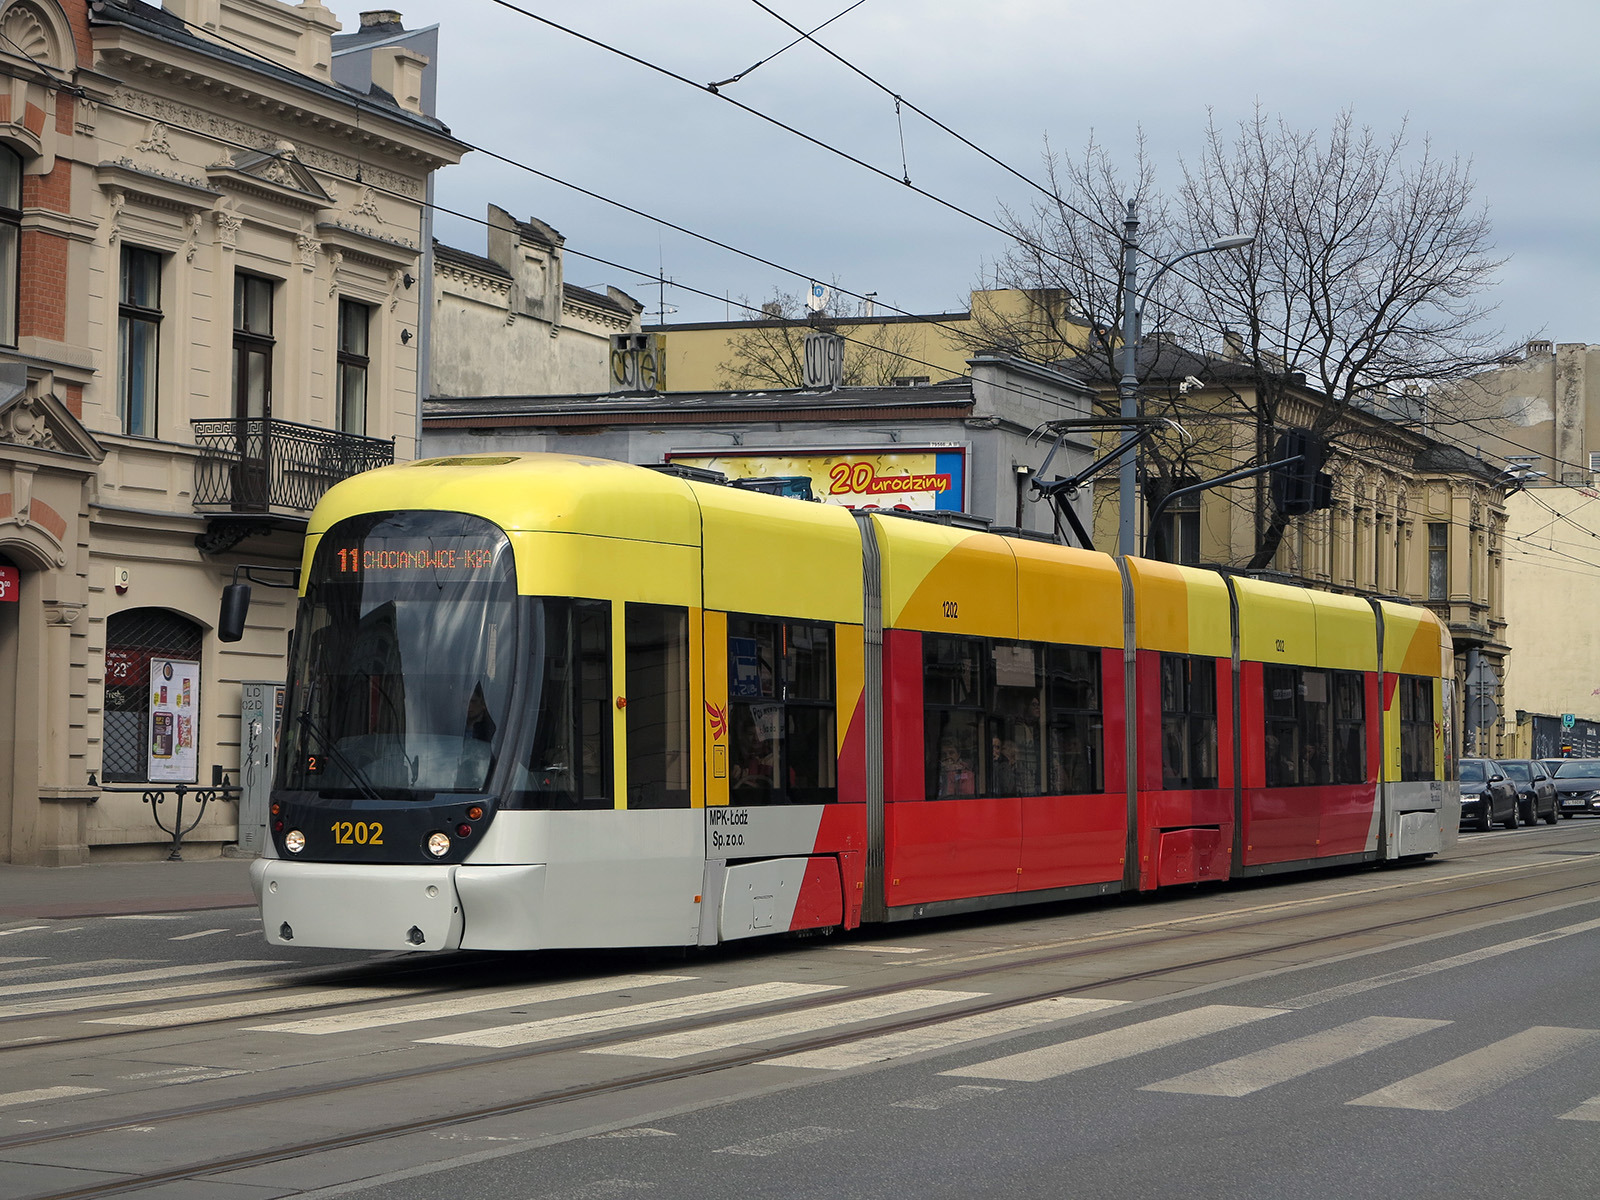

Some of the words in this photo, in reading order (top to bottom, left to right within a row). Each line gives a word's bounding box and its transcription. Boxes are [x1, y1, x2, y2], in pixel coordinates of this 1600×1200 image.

[829, 462, 875, 495] 20
[872, 474, 947, 494] urodziny
[337, 549, 359, 572] 11
[363, 550, 492, 569] CHOCIANOWICE-IKEA
[943, 601, 958, 618] 1202
[1275, 639, 1285, 652] 1202
[246, 687, 261, 697] LD
[308, 757, 317, 770] 2
[710, 809, 748, 826] MPK-Łódź
[331, 821, 384, 845] 1202
